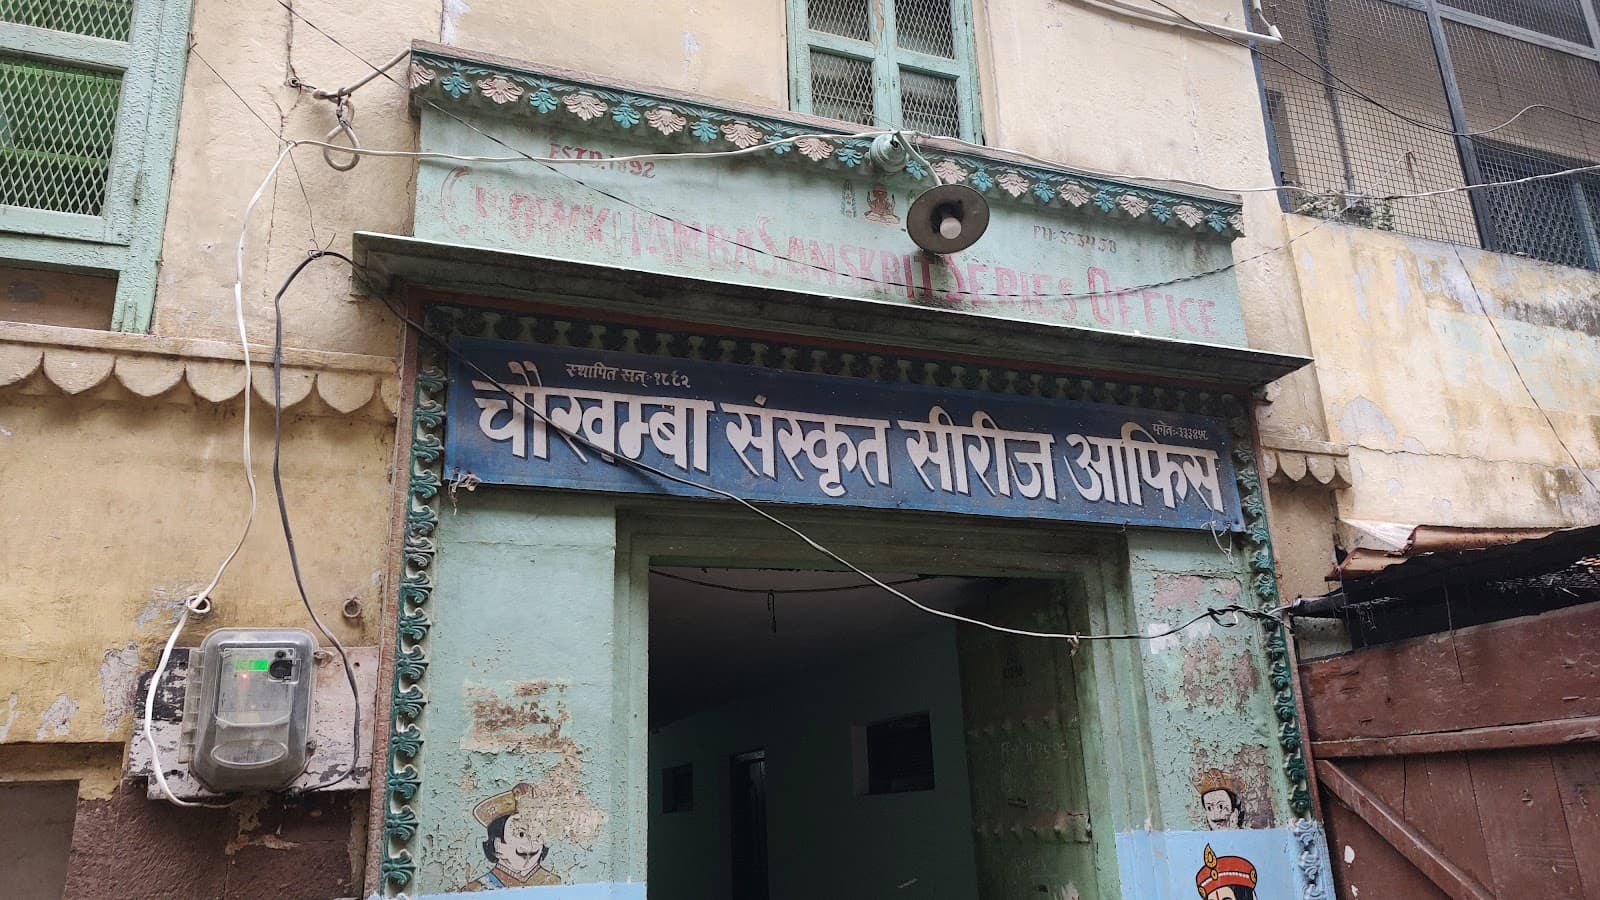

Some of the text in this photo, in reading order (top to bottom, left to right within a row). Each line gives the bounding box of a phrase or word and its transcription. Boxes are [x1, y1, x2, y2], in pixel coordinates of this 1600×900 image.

[752, 214, 935, 300] SANSKRIT
[943, 253, 1078, 322] SERIES
[1087, 266, 1222, 338] OFFICE
[565, 362, 619, 381] स्थापित
[472, 361, 1224, 514] चौखम्बा संस्कृत सीरीज आफिस
